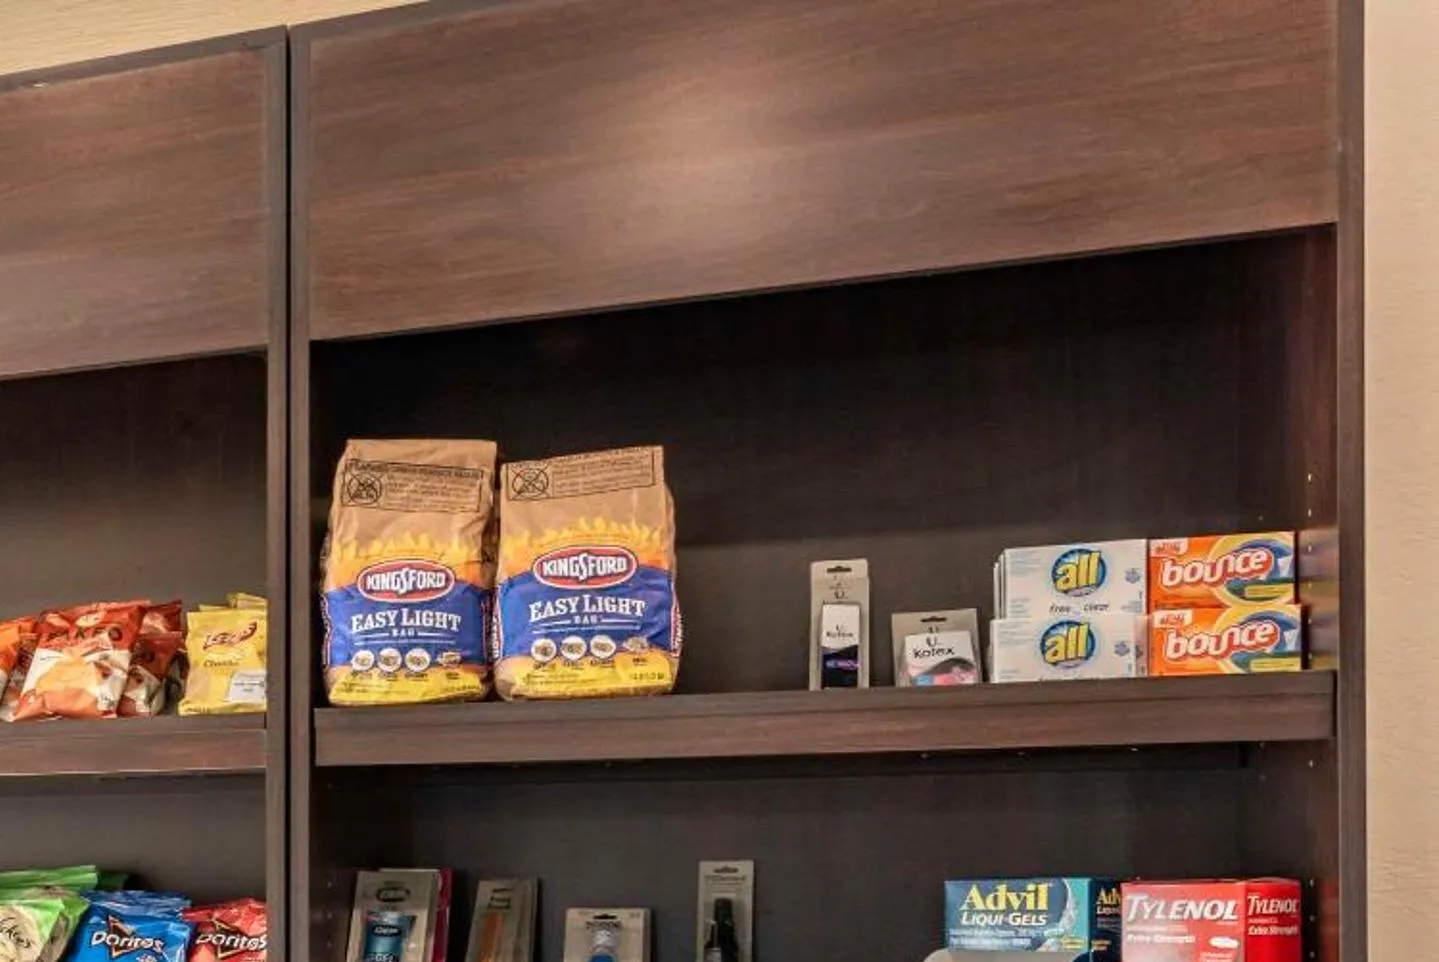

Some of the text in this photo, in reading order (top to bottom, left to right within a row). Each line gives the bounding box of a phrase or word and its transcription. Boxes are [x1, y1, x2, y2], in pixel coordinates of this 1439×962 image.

[542, 553, 628, 582] KINGSFORD
[1055, 551, 1101, 591] all
[1162, 550, 1268, 587] bounce
[366, 568, 446, 595] KINGSFORD
[351, 608, 462, 633] EASY LIGHT
[529, 594, 646, 622] EASY LIGHT
[912, 647, 956, 659] Kotex
[1044, 622, 1090, 664] all
[1166, 620, 1276, 659] bounce
[959, 884, 1049, 911] Advil
[1127, 893, 1239, 922] TYLENOL
[1248, 896, 1298, 915] TYLENOL
[92, 931, 164, 953] Doritos
[196, 932, 268, 951] Doritos
